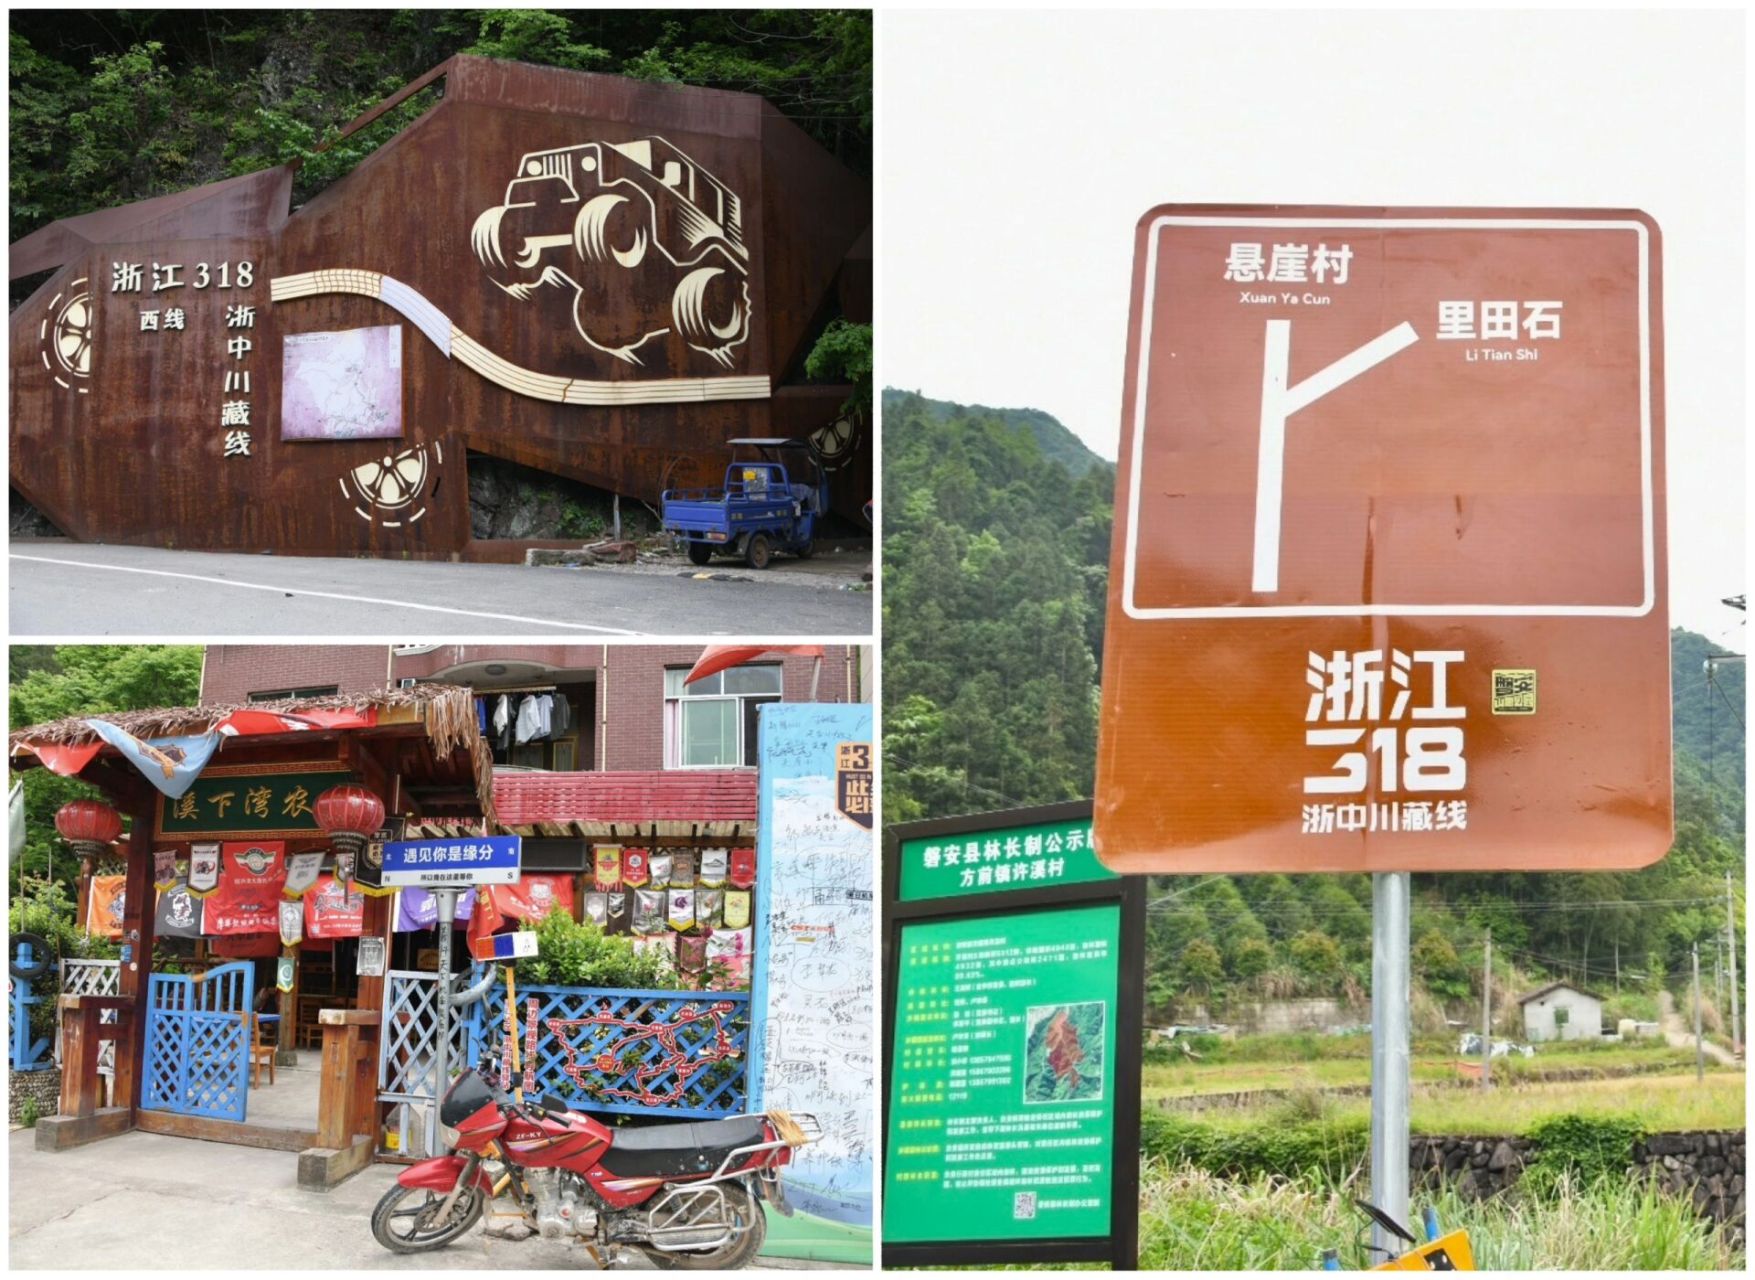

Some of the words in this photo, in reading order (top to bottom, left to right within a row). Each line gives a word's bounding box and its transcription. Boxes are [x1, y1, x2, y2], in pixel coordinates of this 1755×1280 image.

[112, 261, 254, 292] 浙江318
[1223, 242, 1354, 284] 悬崖村
[1240, 291, 1277, 304] Xuan
[1281, 293, 1299, 304] Ya
[1302, 293, 1331, 305] Cun
[140, 308, 185, 331] 西线
[1436, 300, 1563, 340] 里田石
[1466, 349, 1478, 361] Li
[1482, 348, 1512, 360] Tian
[1516, 348, 1538, 360] Shi
[221, 304, 256, 457] 浙中川藏线
[1305, 648, 1467, 722] 浙江
[1303, 726, 1467, 794] 318
[1302, 801, 1468, 834] 浙中川藏线
[404, 844, 494, 863] 遇见你是缘分
[960, 857, 1065, 887] 方前镇许溪村
